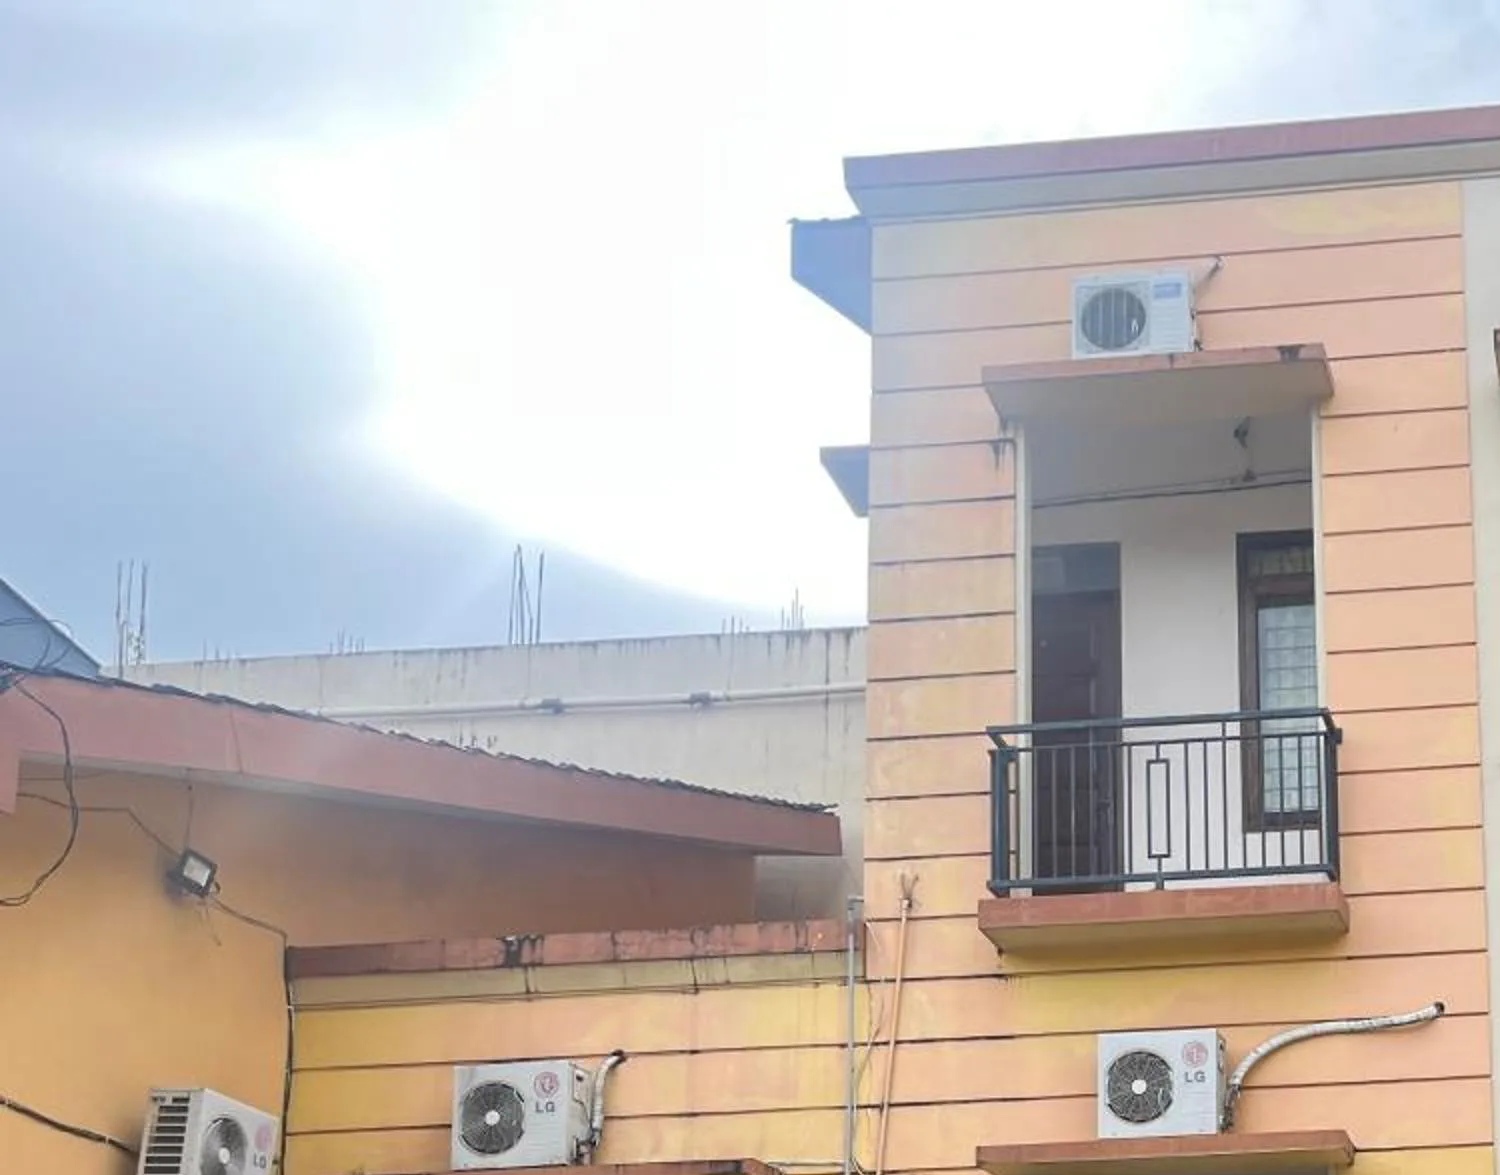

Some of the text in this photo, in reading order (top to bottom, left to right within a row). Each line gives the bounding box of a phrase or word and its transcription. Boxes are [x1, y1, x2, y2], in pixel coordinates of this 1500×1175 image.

[1184, 1070, 1206, 1083] LG
[535, 1101, 556, 1114] LG
[253, 1152, 268, 1169] LG
